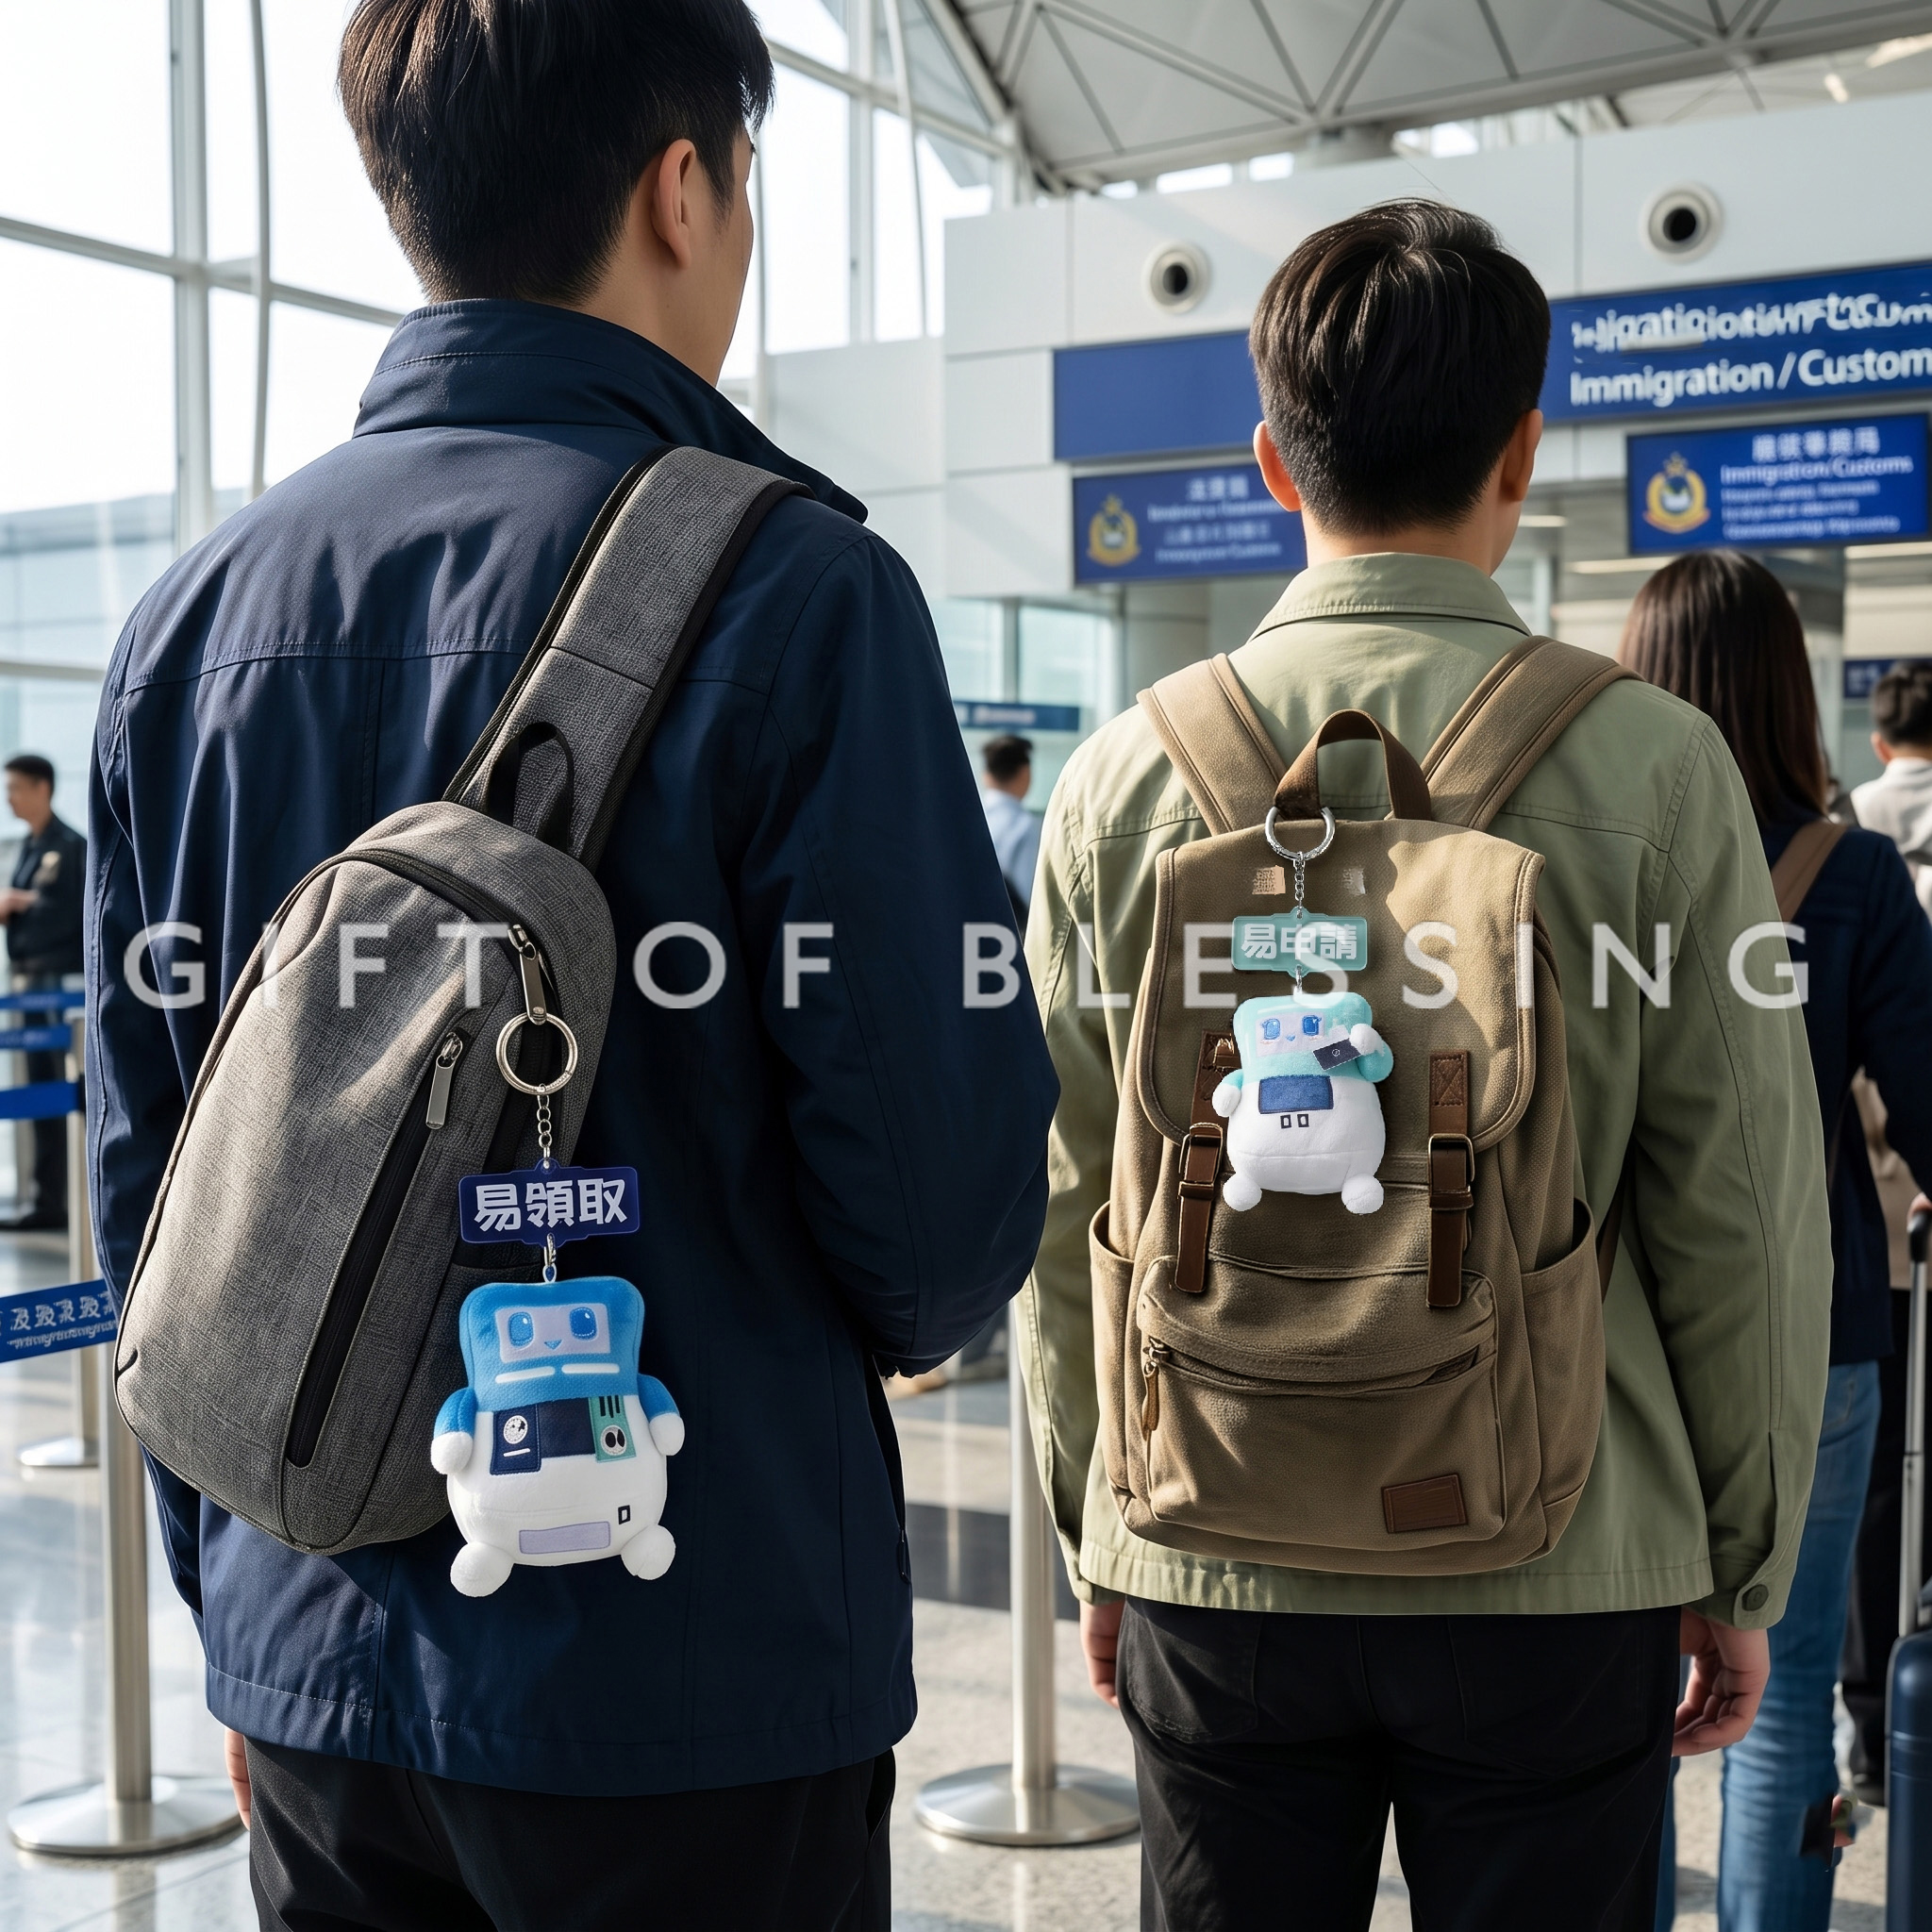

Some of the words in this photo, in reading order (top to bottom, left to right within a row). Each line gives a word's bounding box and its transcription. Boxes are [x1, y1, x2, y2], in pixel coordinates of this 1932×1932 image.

[1571, 358, 1775, 408] Immigration
[1241, 924, 1357, 960] 易申請
[474, 1178, 628, 1232] 易領取
